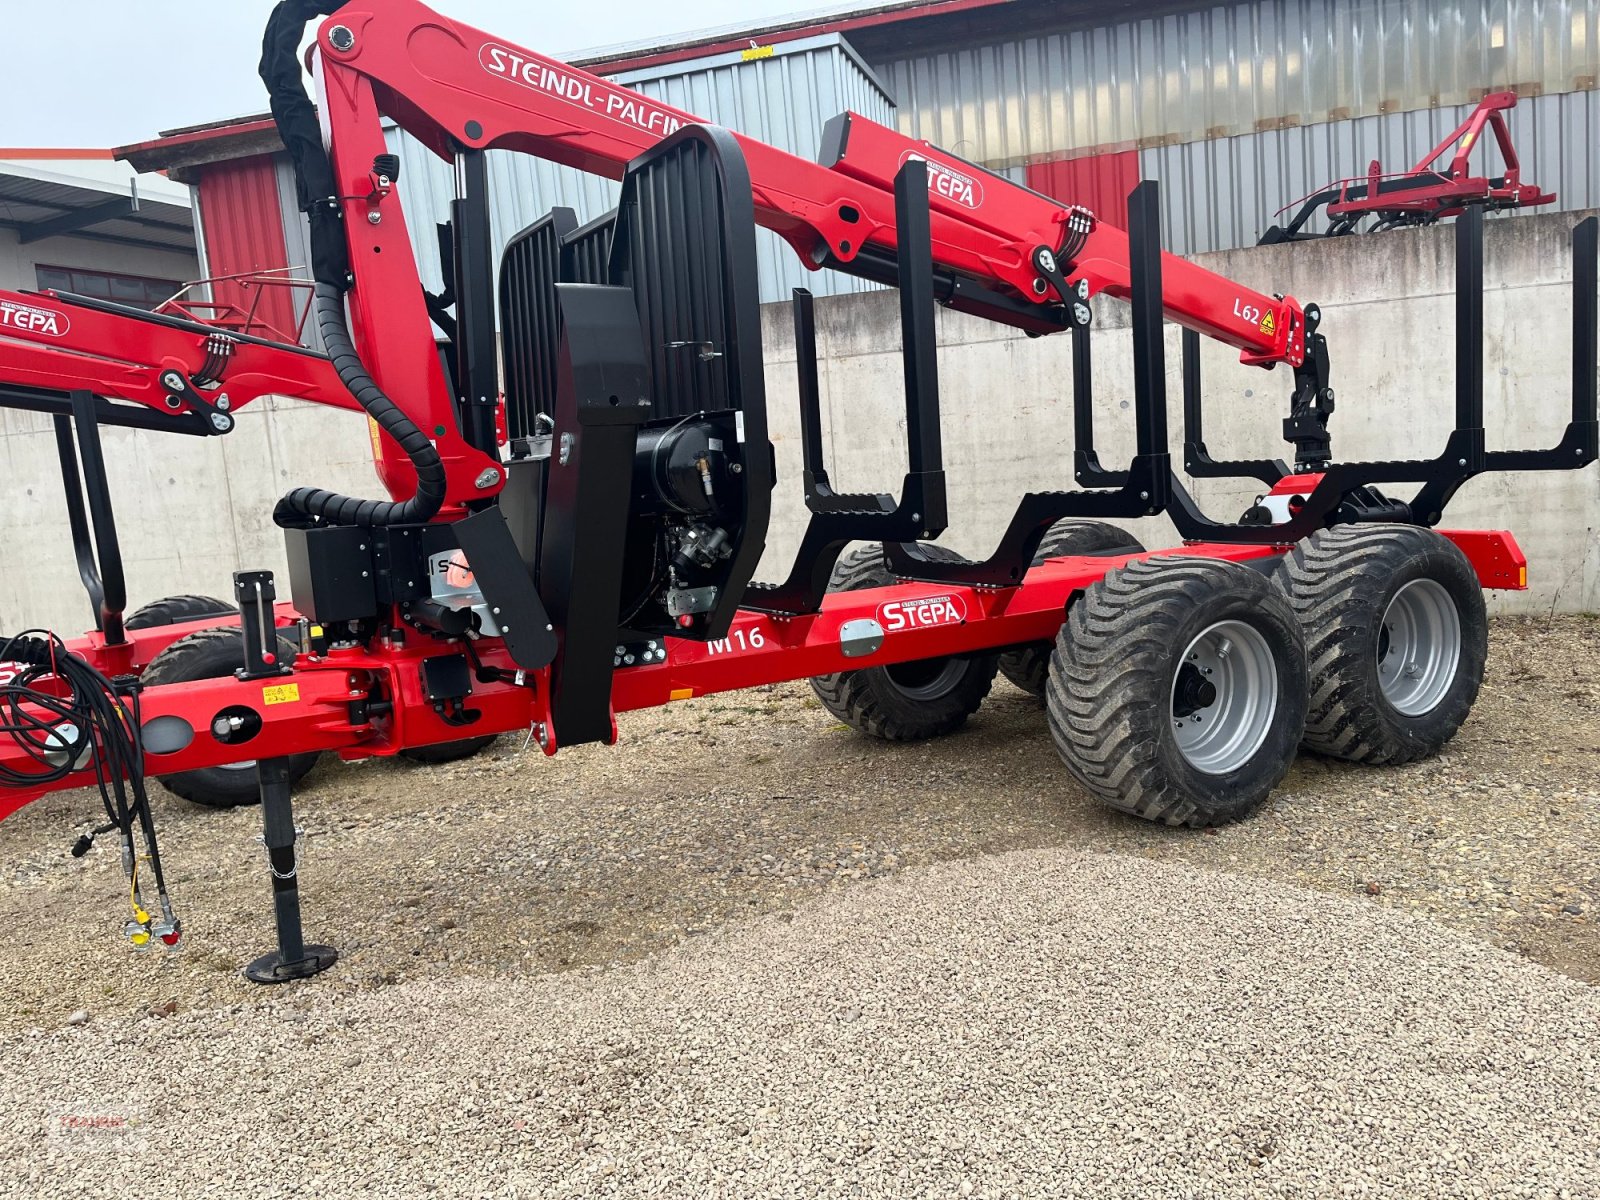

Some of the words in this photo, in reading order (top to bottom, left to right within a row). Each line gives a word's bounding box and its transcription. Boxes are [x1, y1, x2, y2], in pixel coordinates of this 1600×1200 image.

[907, 154, 974, 206] TEPA
[1233, 298, 1260, 325] L62
[882, 602, 961, 630] STEPA
[734, 626, 765, 650] 16
